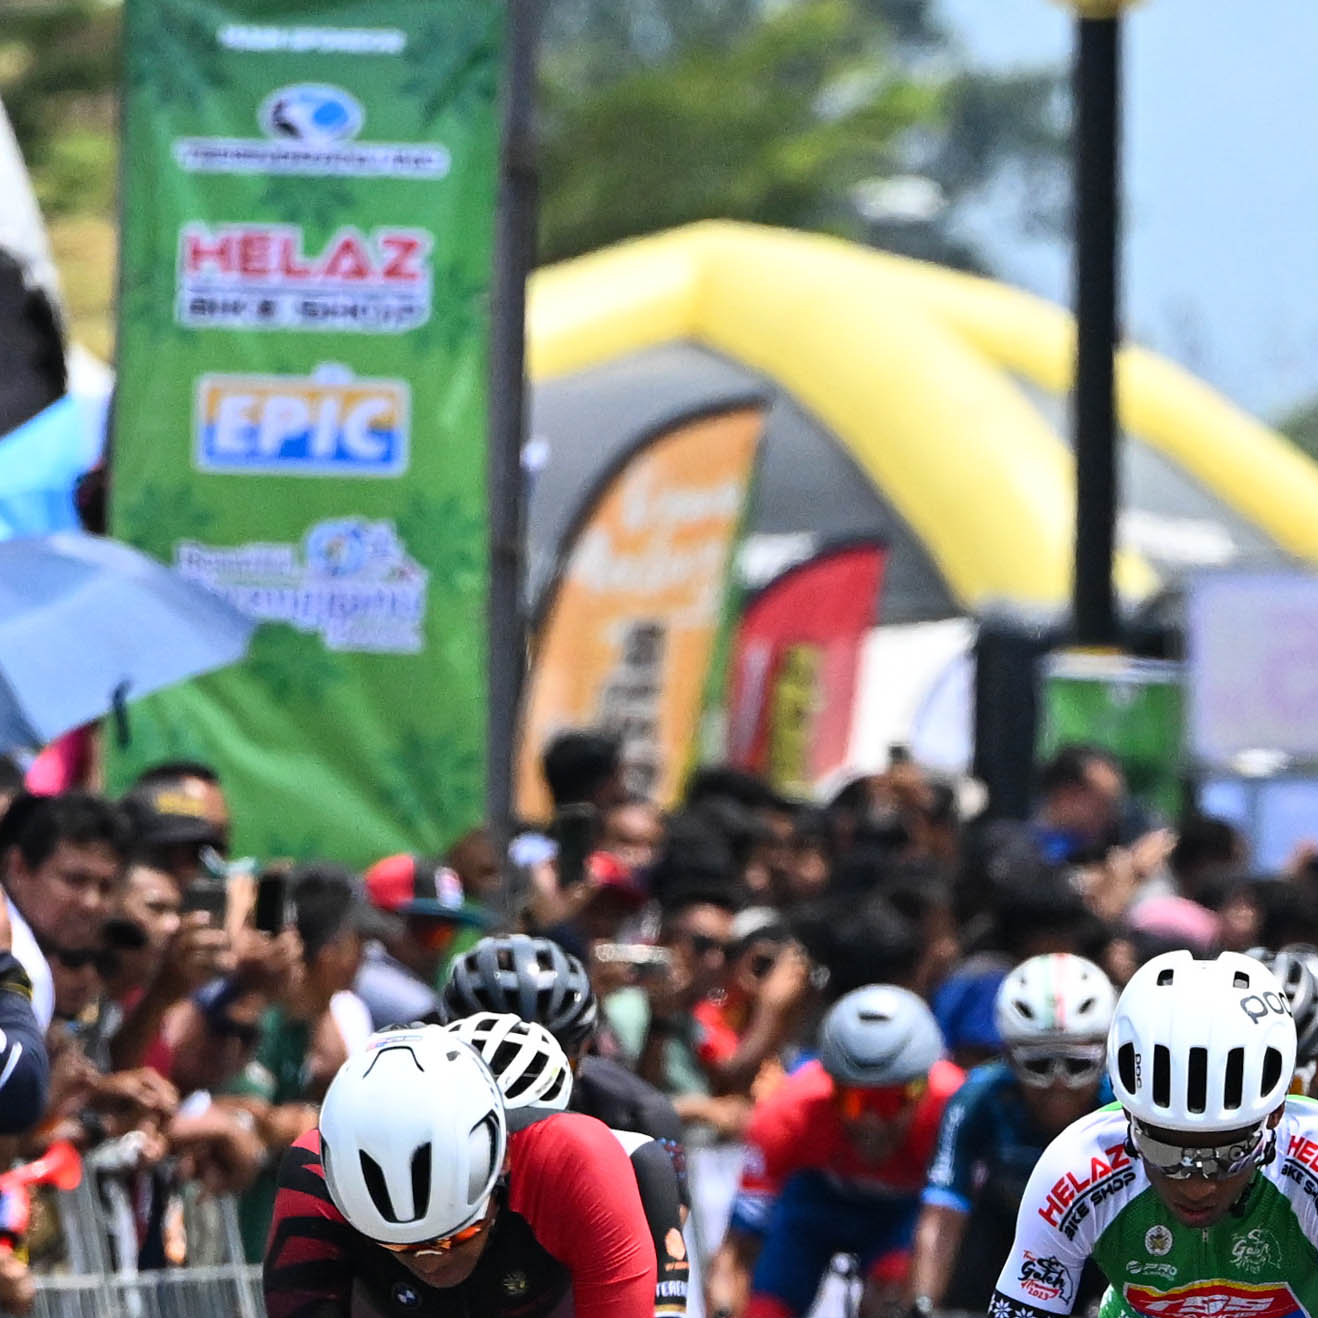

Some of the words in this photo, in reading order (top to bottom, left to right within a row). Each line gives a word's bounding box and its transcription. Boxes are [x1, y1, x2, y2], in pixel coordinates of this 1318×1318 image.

[187, 230, 420, 280] HELAZ
[214, 396, 394, 458] EPIC
[1037, 1143, 1131, 1228] HELAZ
[1063, 1202, 1090, 1242] BIKE
[1089, 1171, 1137, 1208] SHOP
[1027, 1287, 1050, 1301] 2023
